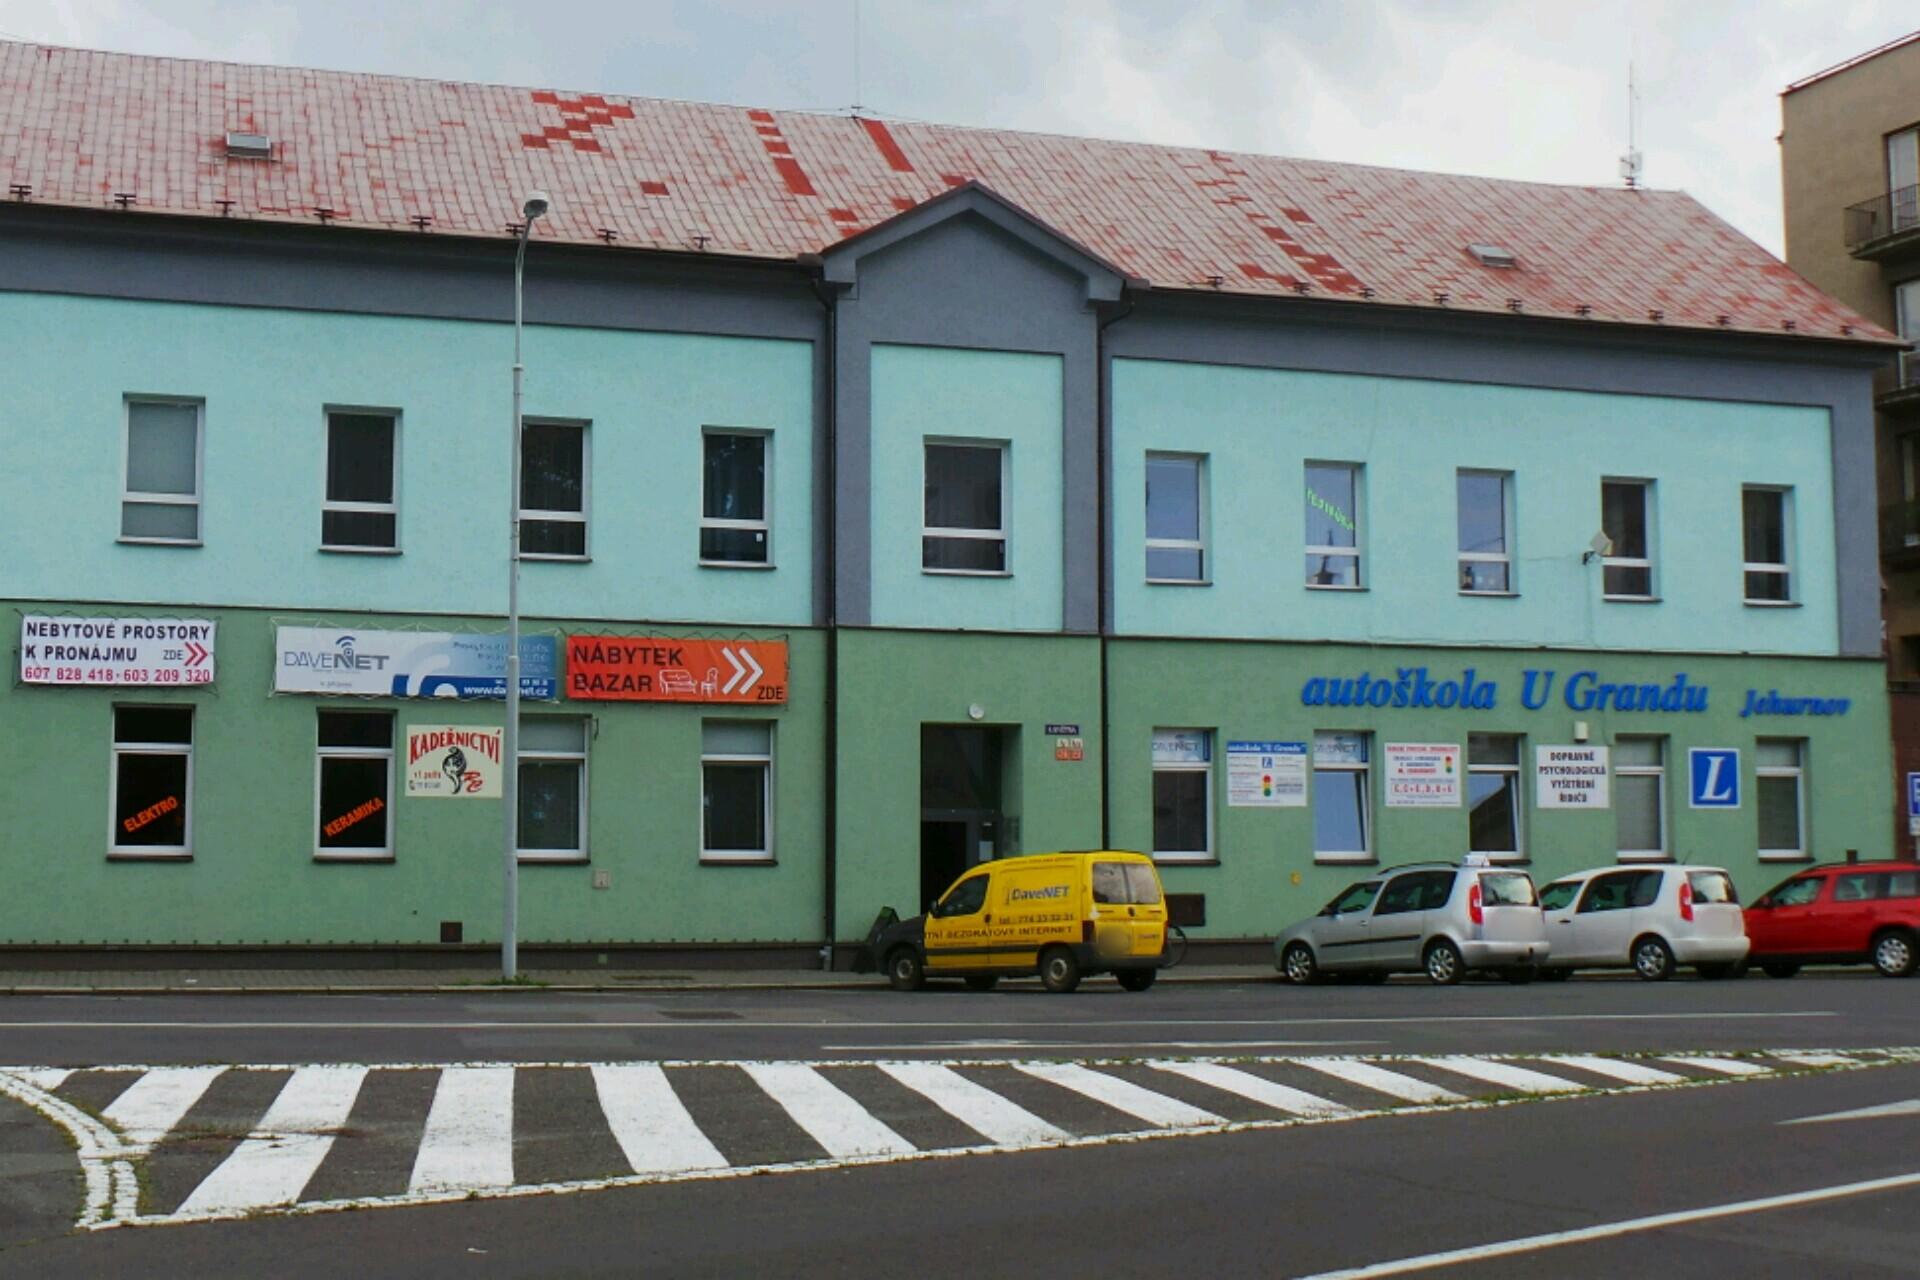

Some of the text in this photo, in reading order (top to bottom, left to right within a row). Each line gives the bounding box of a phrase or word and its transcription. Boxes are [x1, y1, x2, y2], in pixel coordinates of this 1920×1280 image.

[26, 621, 210, 640] NEBYTOVÉ PROSTORY
[25, 643, 184, 662] K PRONÁJMU ZDE
[573, 643, 684, 666] NÁBYTEK
[25, 666, 50, 679] 607
[56, 667, 82, 681] 828
[154, 669, 180, 682] 209
[185, 669, 210, 682] 320
[574, 672, 653, 693] BAZAR
[757, 685, 784, 700] ZDE
[1301, 667, 1496, 709] autoškola
[1521, 670, 1555, 710] U
[1564, 671, 1709, 712] Grandu
[410, 727, 500, 765] KADEŘNICTVÍ
[1700, 755, 1731, 800] L
[124, 795, 178, 833] ELEKTRO
[323, 796, 384, 837] KERAMIKA
[1019, 926, 1073, 936] INTERNET
